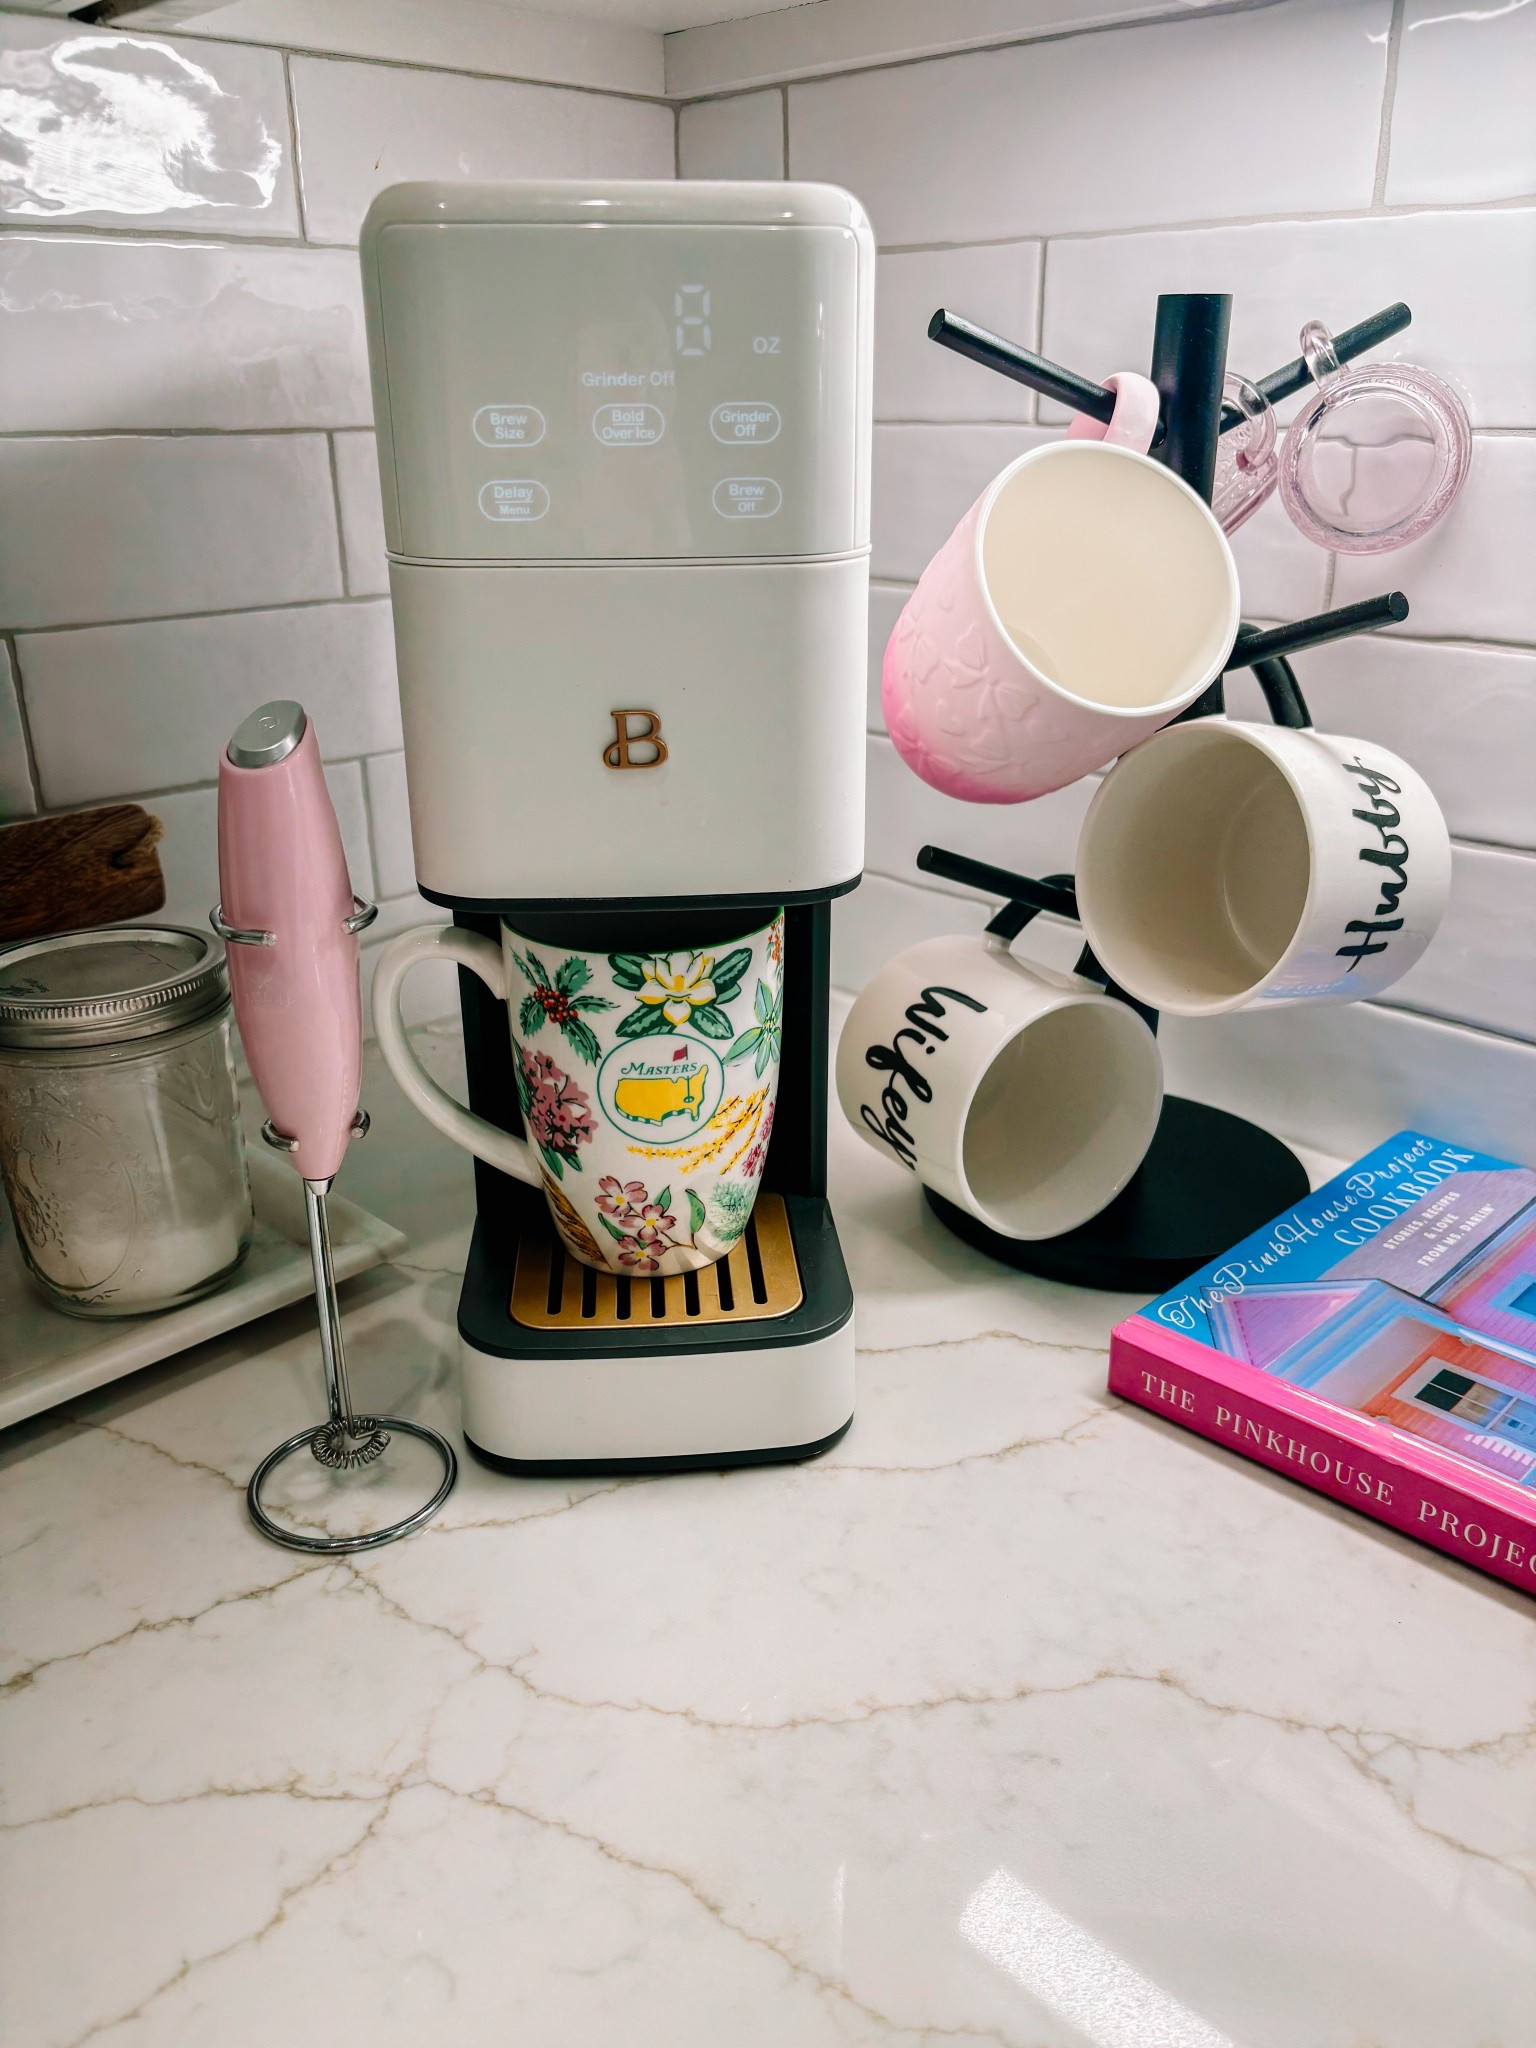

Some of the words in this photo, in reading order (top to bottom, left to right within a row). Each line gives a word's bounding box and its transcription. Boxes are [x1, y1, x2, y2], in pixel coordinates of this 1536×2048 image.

[581, 372, 645, 387] Grinder
[650, 371, 675, 387] Off
[490, 412, 528, 425] Brew
[611, 410, 645, 423] Bold
[719, 410, 773, 423] Grinder
[495, 426, 525, 440] Size
[602, 427, 634, 440] Over
[635, 427, 655, 440] Ice
[734, 424, 757, 437] Off
[494, 486, 534, 500] Delay
[729, 484, 765, 496] Brew
[499, 504, 530, 516] Menu
[738, 502, 756, 513] Off
[603, 709, 668, 769] B
[1335, 756, 1409, 973] Hubby
[860, 986, 988, 1171] Wifey
[1345, 1139, 1433, 1199] Project
[1333, 1148, 1475, 1246] COOKBOOK
[1382, 1216, 1428, 1250] STORIES,
[1421, 1191, 1461, 1219] RECIPES
[1423, 1229, 1435, 1239] &
[1433, 1212, 1459, 1233] LOVE
[1417, 1242, 1448, 1267] FROM
[1444, 1231, 1465, 1247] MS.
[1142, 1371, 1195, 1412] THE
[1215, 1405, 1394, 1505] PINKHOUSE
